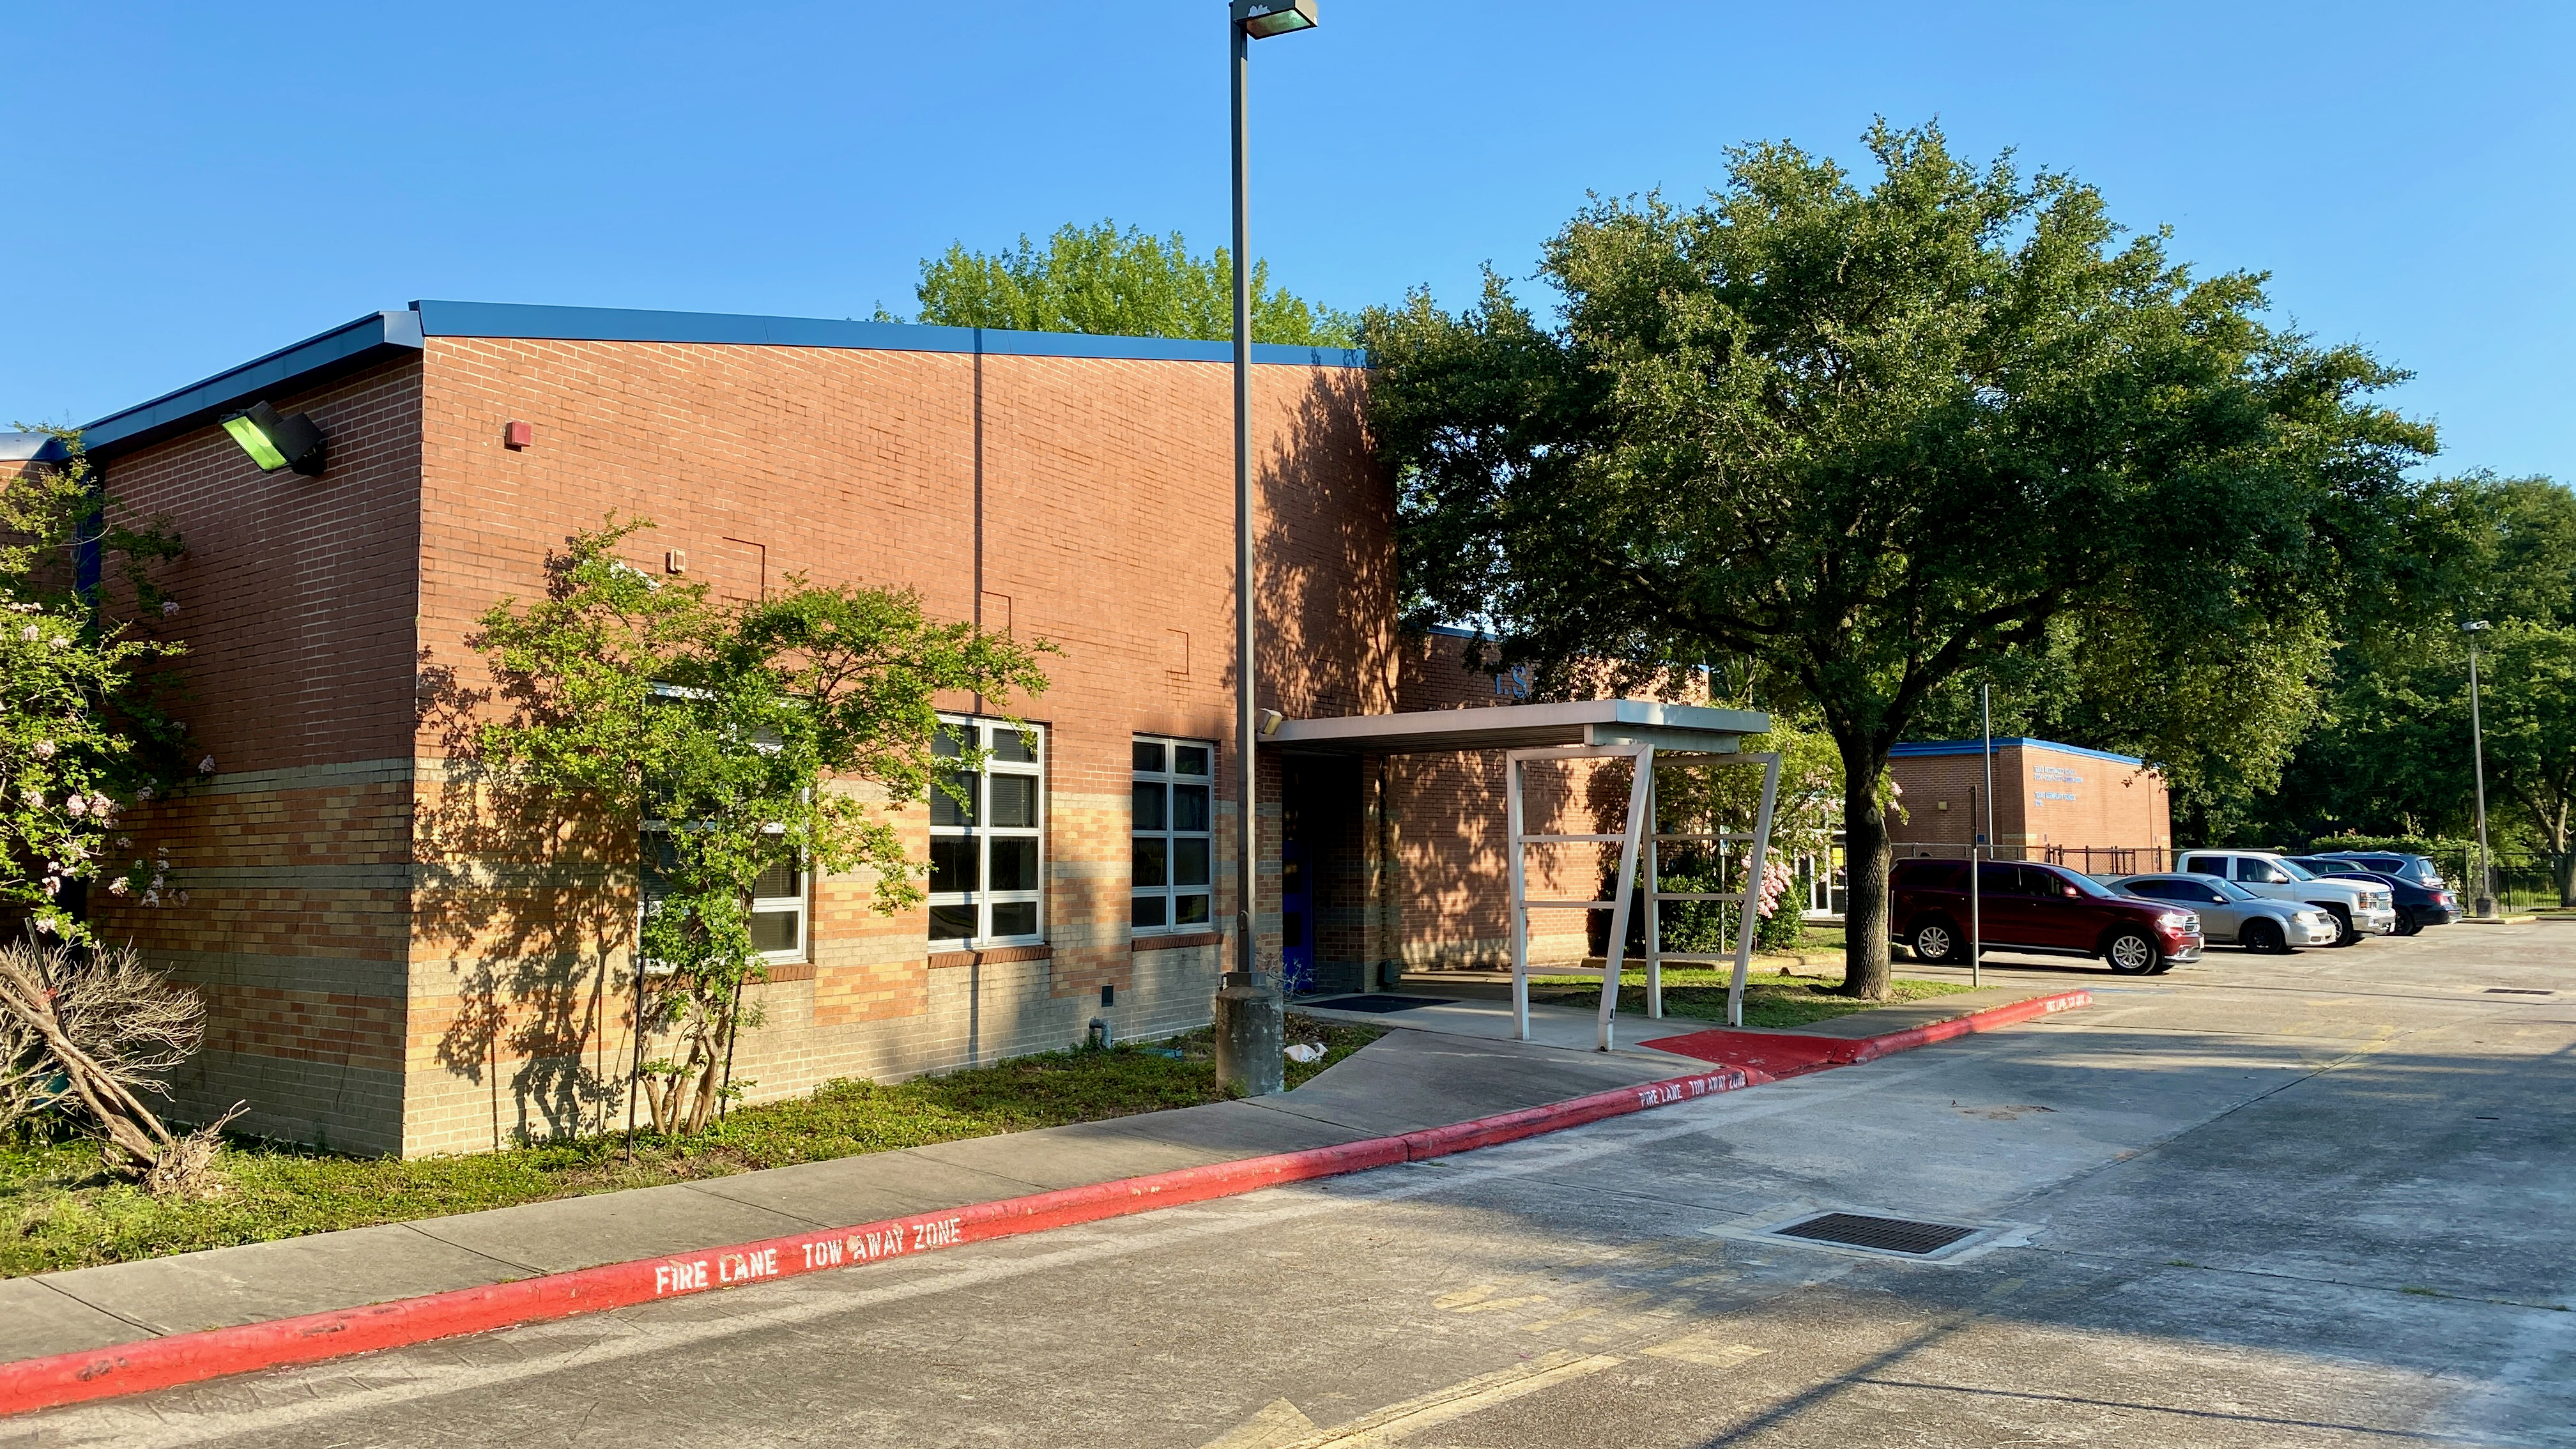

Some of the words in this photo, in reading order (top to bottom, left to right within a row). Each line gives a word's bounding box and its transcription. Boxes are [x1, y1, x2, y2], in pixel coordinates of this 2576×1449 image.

[1638, 1089, 1659, 1108] FIRE
[1660, 1084, 1683, 1103] LANE
[1688, 1079, 1705, 1096] TOW
[1708, 1074, 1726, 1093] AWAY
[1729, 1071, 1746, 1089] ZONE
[654, 1261, 709, 1294] FIRE
[719, 1248, 779, 1282] LANE
[802, 1238, 844, 1269] TOW
[852, 1226, 905, 1260] AWAY
[913, 1217, 962, 1250] ZONE
